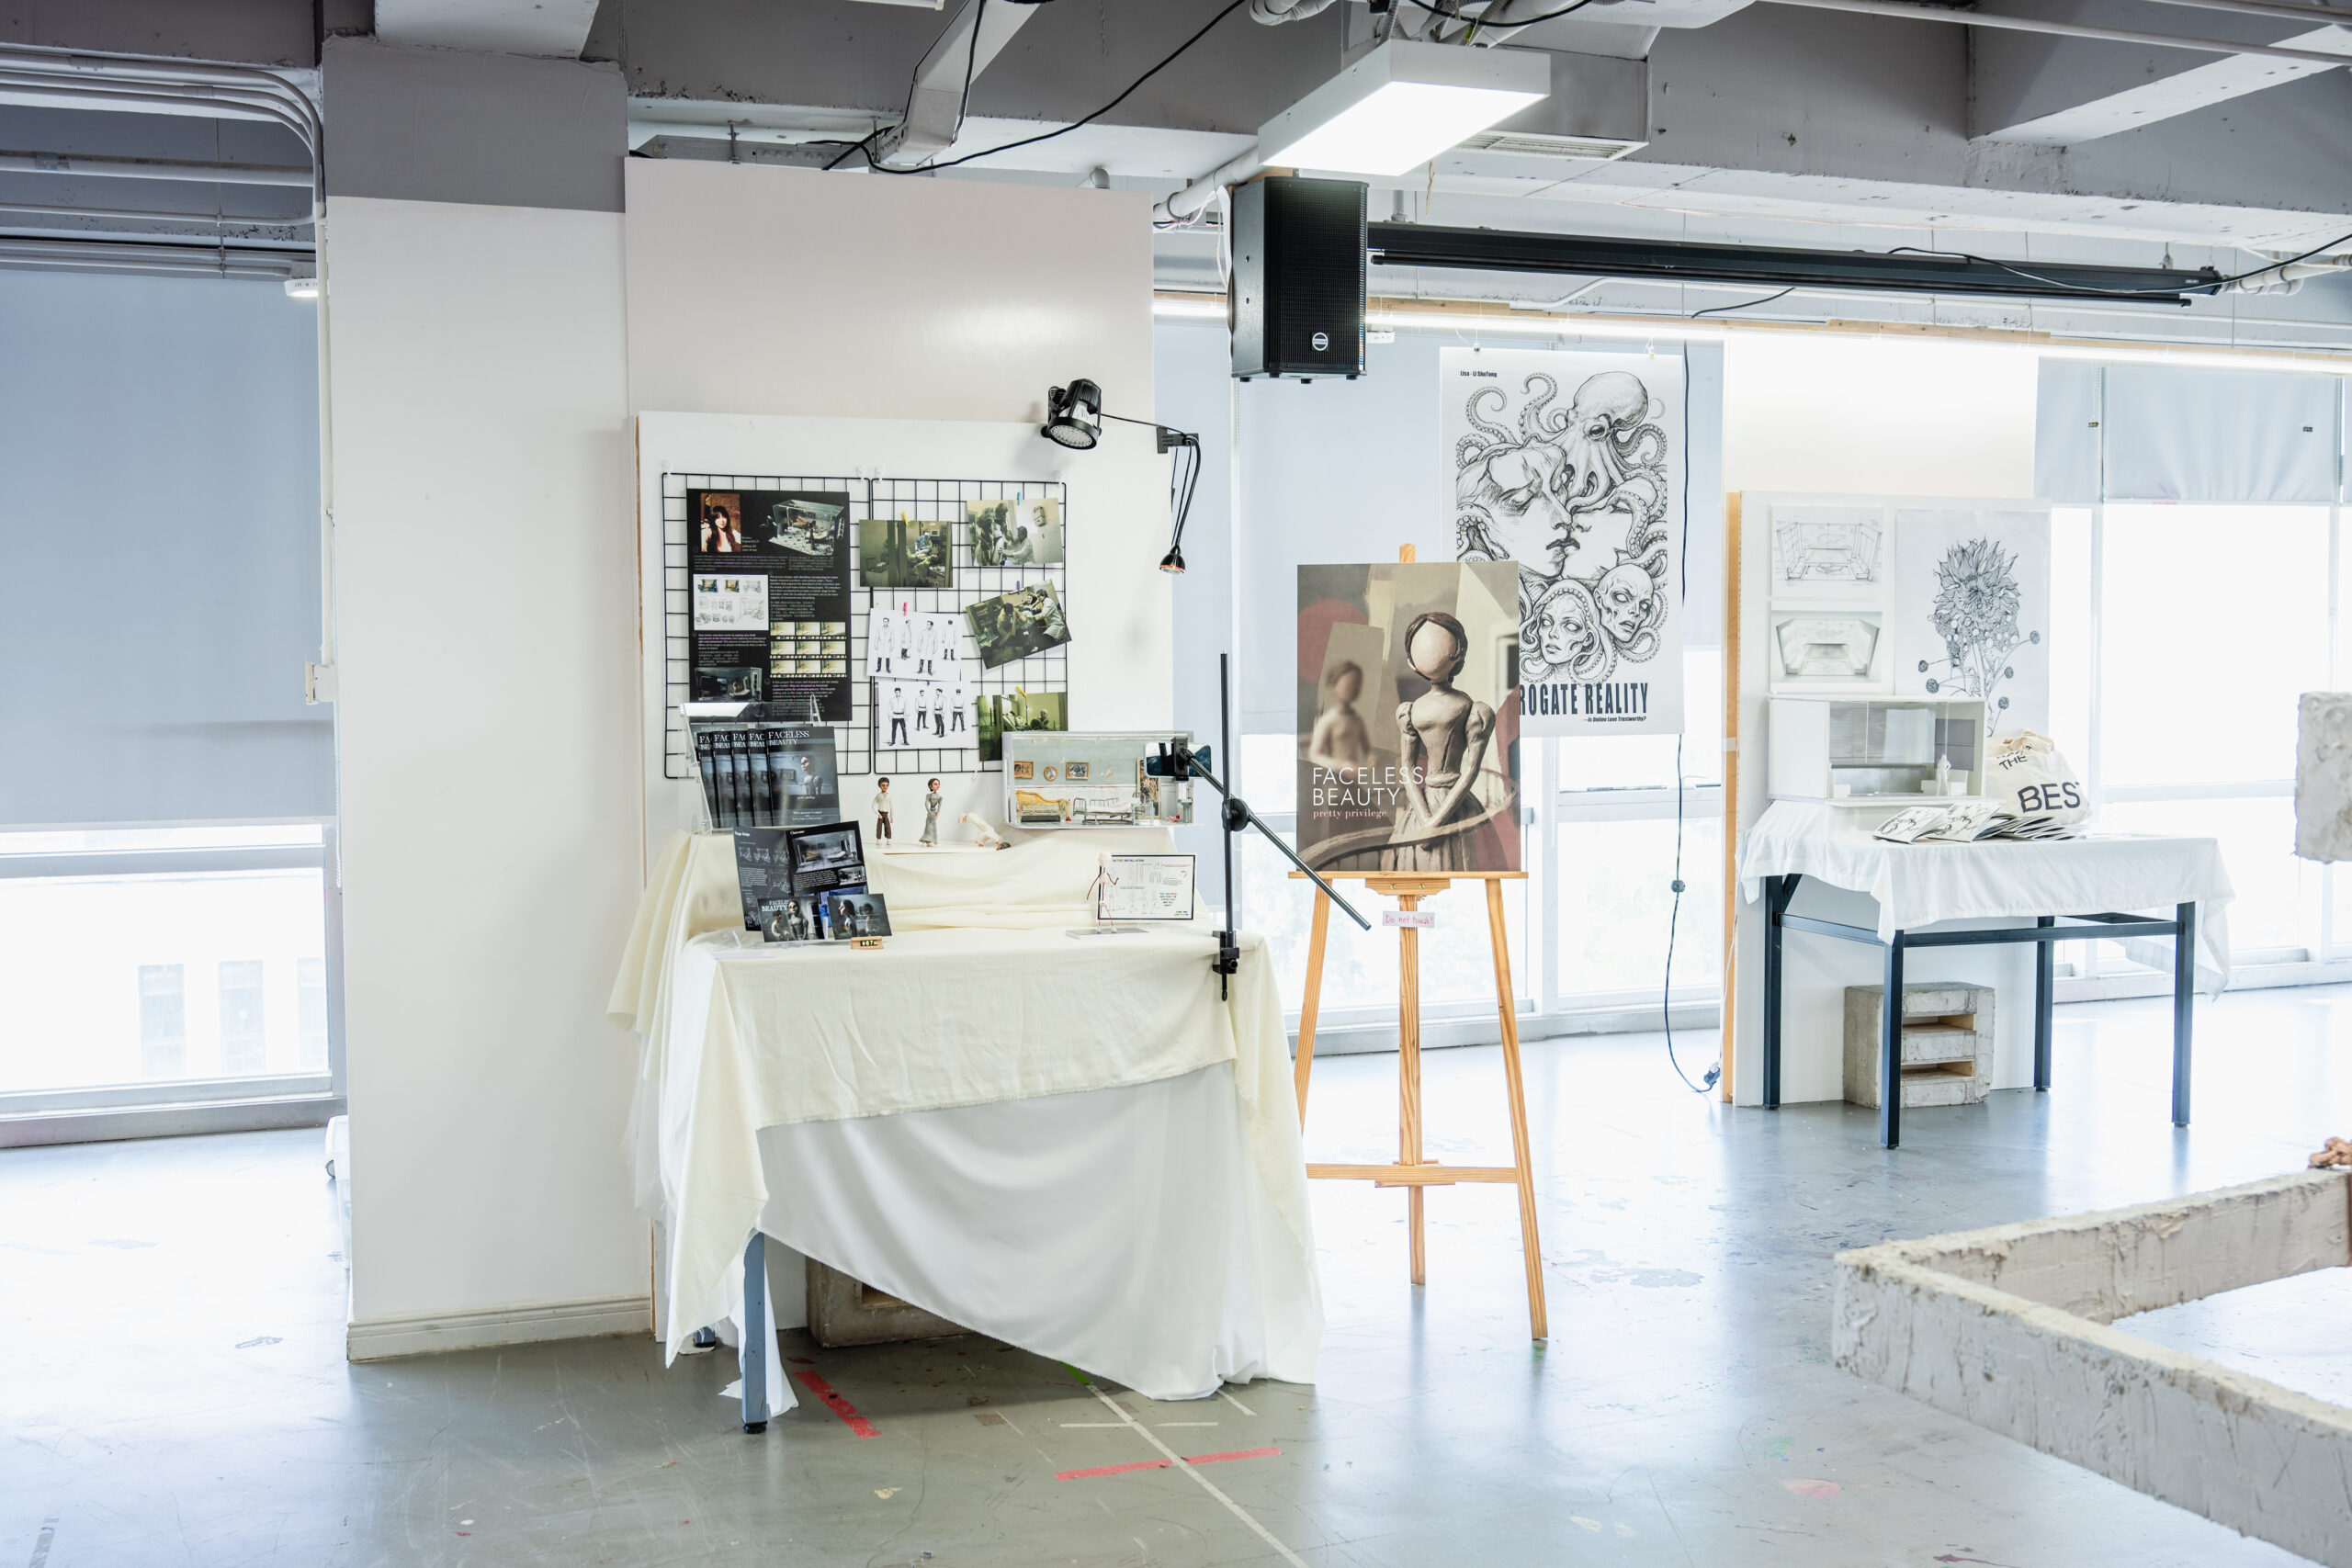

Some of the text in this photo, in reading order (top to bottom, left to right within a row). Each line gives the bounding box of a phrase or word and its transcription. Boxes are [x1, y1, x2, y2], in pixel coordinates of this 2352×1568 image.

[1585, 682, 1648, 715] REALITY
[768, 730, 810, 739] FACELESS
[769, 739, 797, 747] BEAUTY
[1998, 755, 2028, 771] THE
[1313, 766, 1424, 784] FACELESS
[1313, 787, 1400, 807] BEAUTY
[2017, 781, 2081, 814] BES
[1313, 808, 1388, 819] pretty privilege
[1385, 914, 1396, 924] Do
[1398, 916, 1409, 924] not
